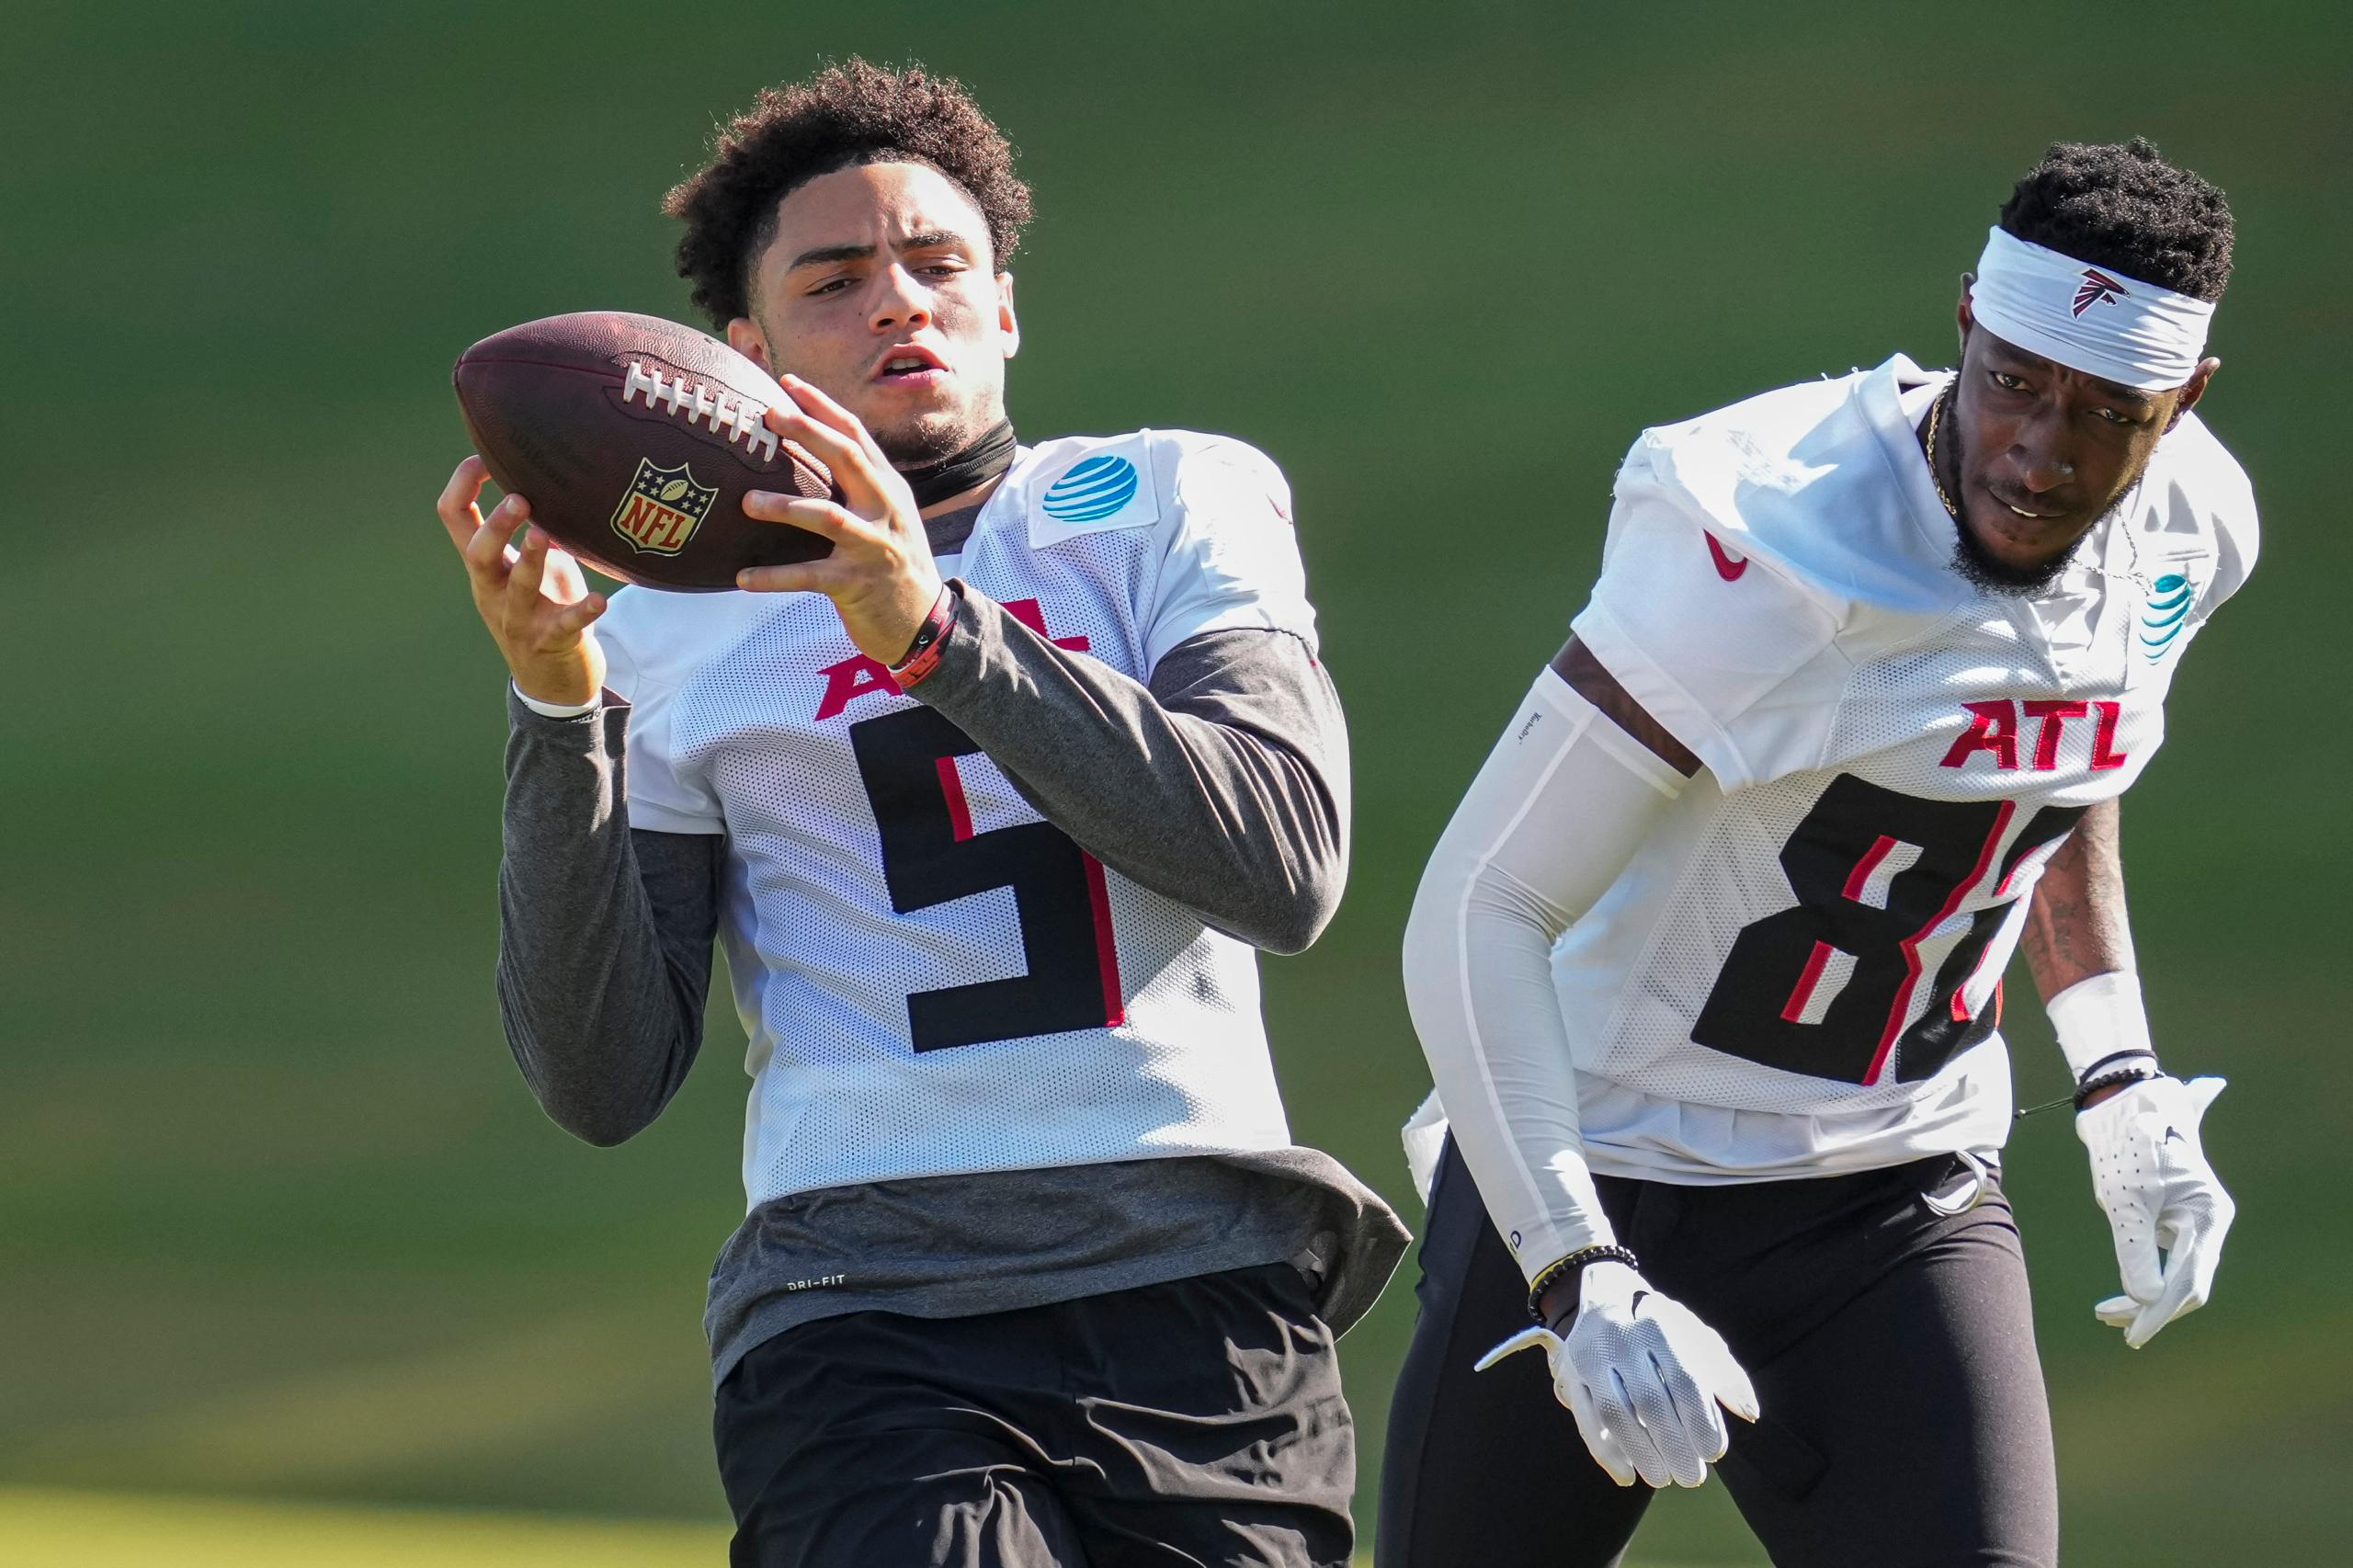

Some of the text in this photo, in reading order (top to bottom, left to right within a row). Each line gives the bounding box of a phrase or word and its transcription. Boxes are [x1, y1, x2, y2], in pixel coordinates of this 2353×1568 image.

[620, 495, 686, 549] NFL
[1939, 699, 2127, 771] ATL
[847, 704, 1125, 1053] 5
[787, 1274, 845, 1290] DRI-FIT
